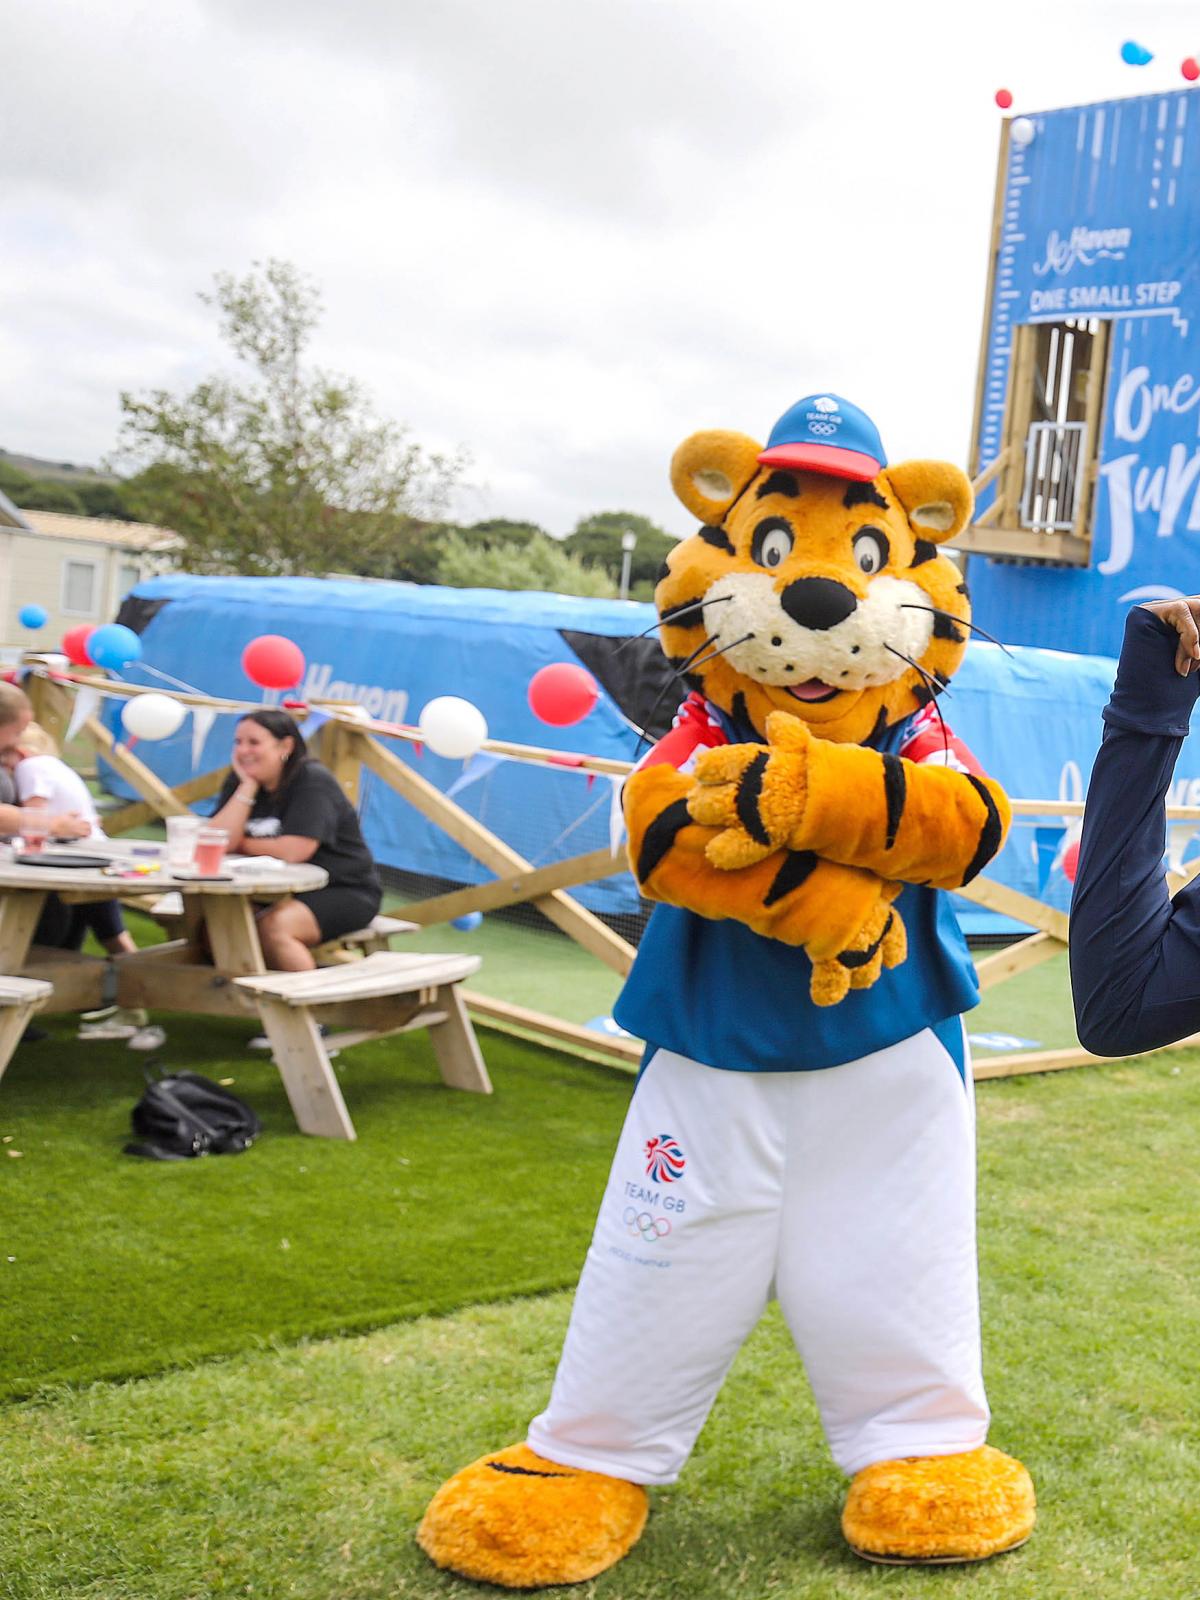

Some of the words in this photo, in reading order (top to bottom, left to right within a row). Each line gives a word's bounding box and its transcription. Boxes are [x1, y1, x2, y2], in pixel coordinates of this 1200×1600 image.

[1030, 288, 1066, 312] ONE
[1069, 285, 1132, 308] SMALL
[1136, 281, 1182, 305] STEP
[624, 1181, 660, 1205] TEAM
[662, 1196, 686, 1213] GB
